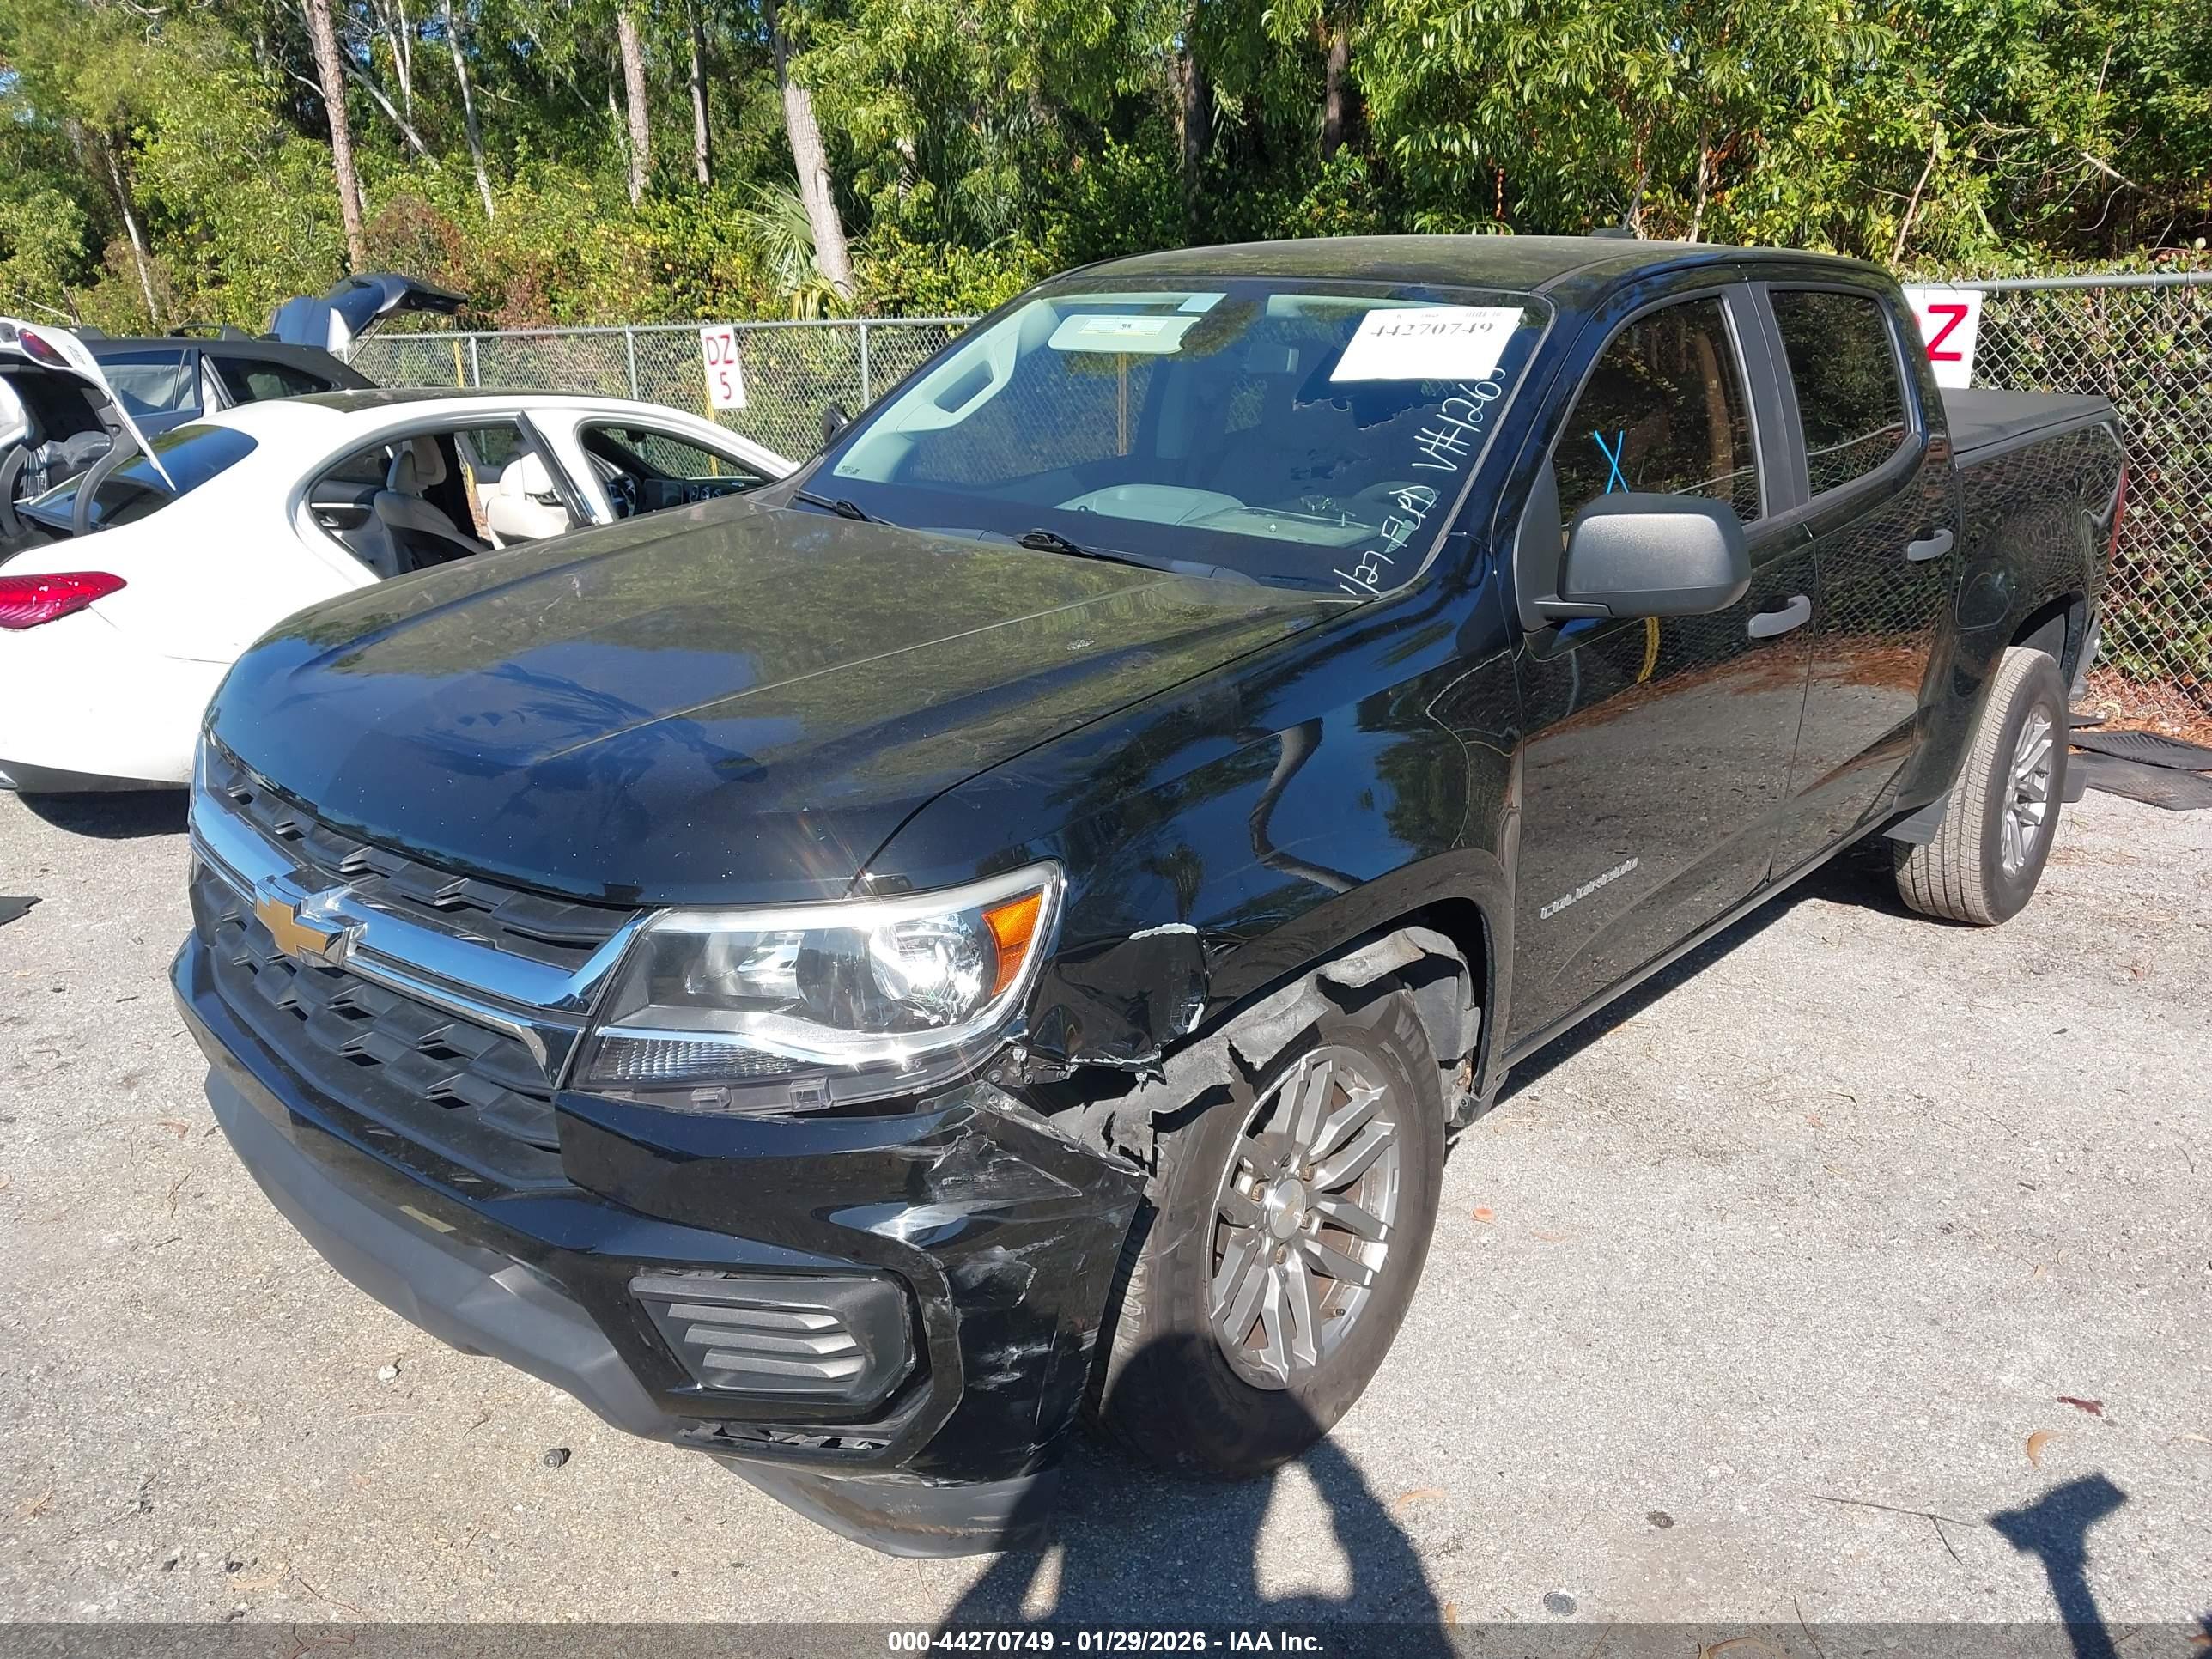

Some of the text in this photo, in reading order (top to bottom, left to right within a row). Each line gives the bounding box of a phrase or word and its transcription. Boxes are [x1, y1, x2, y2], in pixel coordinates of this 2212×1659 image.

[705, 333, 735, 365] DZ
[1912, 303, 1969, 362] Z
[720, 371, 732, 400] 5
[1540, 857, 1638, 920] COLORADO
